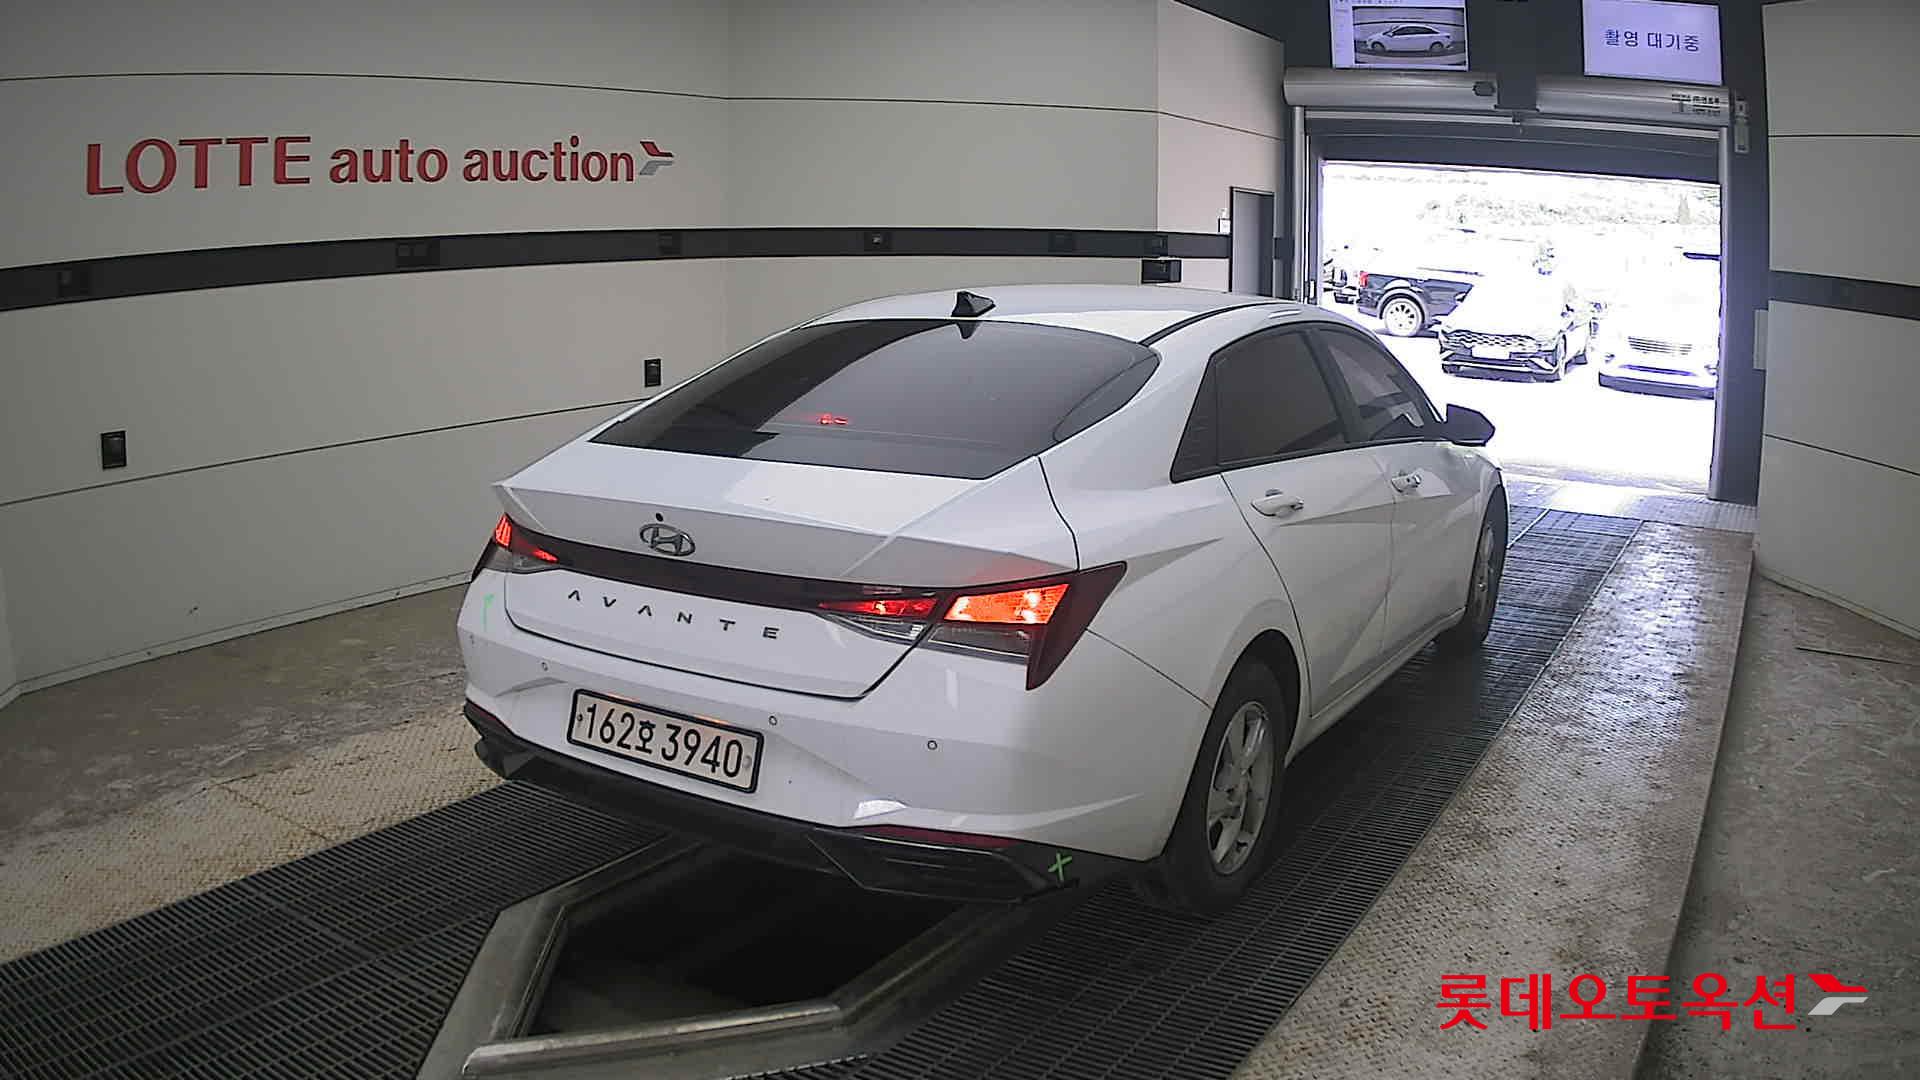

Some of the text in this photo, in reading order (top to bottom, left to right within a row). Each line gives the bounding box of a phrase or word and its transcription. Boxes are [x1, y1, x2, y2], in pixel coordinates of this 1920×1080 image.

[1604, 29, 1701, 52] 촬영 대기중
[86, 135, 634, 196] LOTTE auto auction
[568, 589, 780, 640] AVANTE
